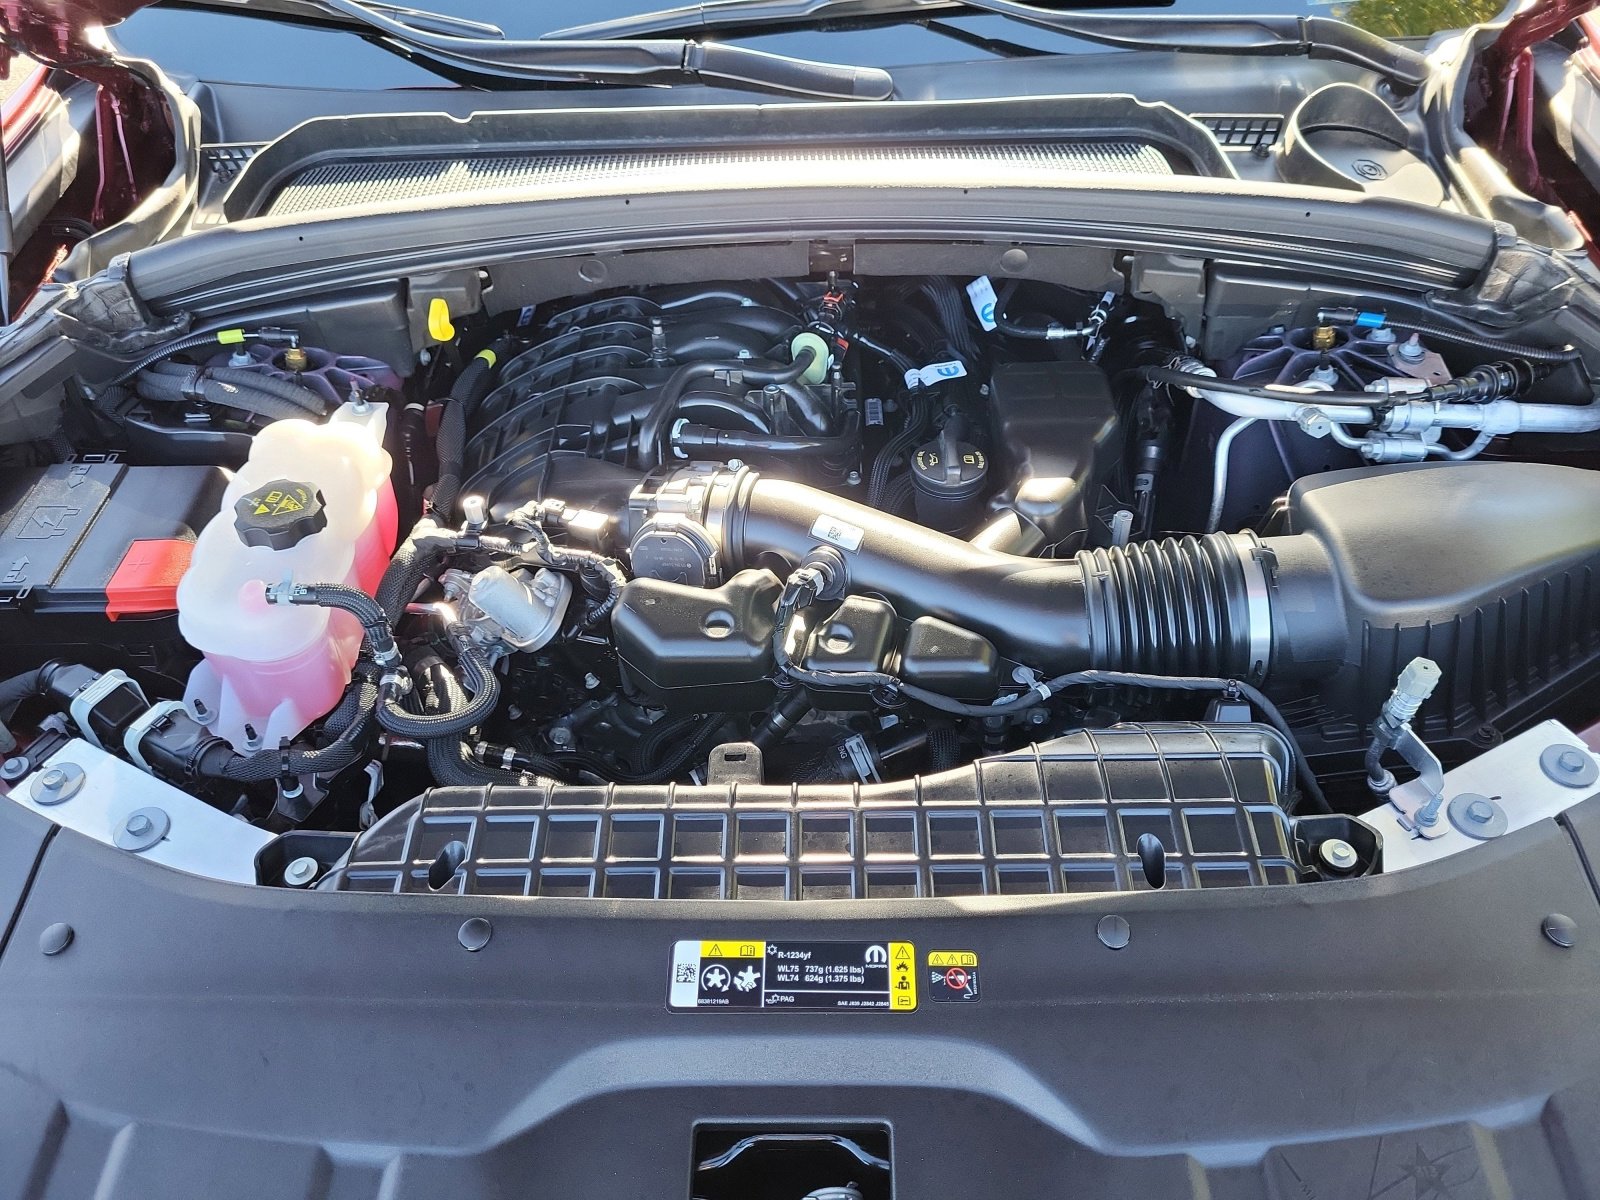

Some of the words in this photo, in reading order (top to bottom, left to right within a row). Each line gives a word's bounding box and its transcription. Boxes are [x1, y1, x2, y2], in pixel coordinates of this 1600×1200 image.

[837, 745, 848, 759] ENG
[778, 951, 812, 960] R-1234yf
[777, 965, 799, 973] WL75
[805, 965, 824, 974] 737g
[825, 965, 848, 974] (1.625
[849, 966, 865, 974] lbs)
[777, 974, 799, 982] WL74
[804, 975, 824, 984] 624g
[825, 975, 848, 984] (1.375
[849, 975, 865, 984] lbs)
